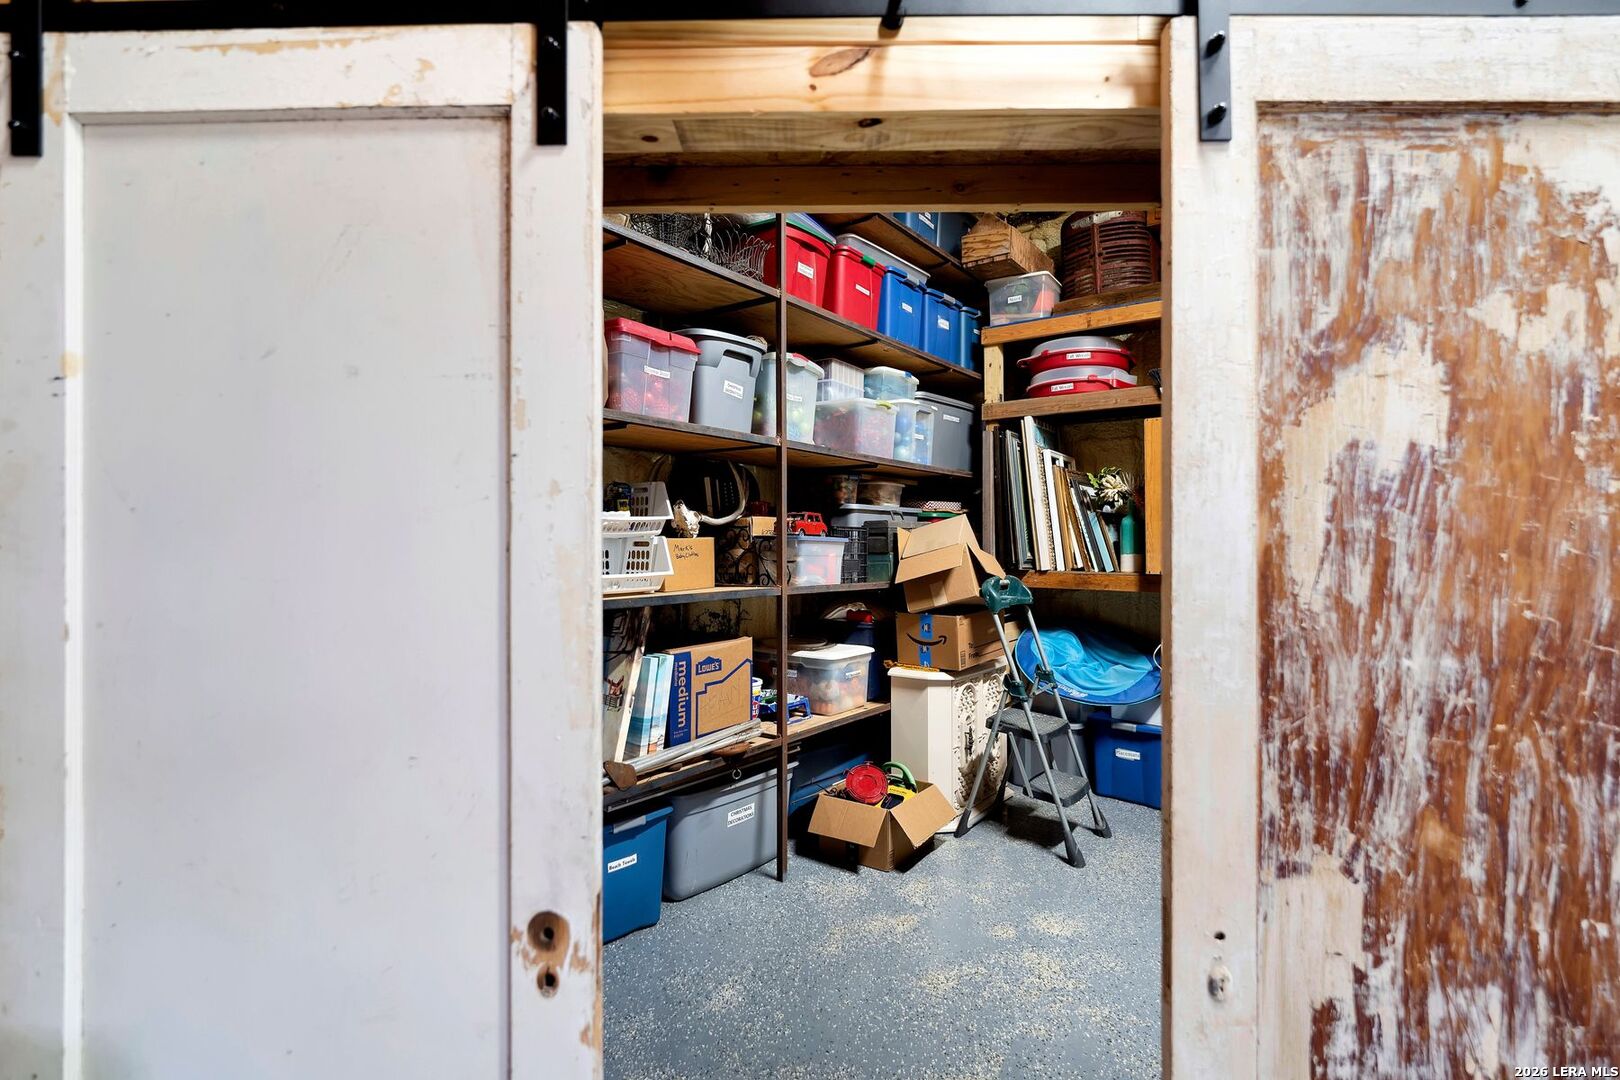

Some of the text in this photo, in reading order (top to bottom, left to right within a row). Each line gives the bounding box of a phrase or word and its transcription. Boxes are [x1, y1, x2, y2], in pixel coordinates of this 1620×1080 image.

[698, 661, 720, 673] LOWE'S
[678, 661, 689, 728] medium
[730, 805, 753, 817] CHRISTMAS
[728, 812, 754, 825] DECORATIONS
